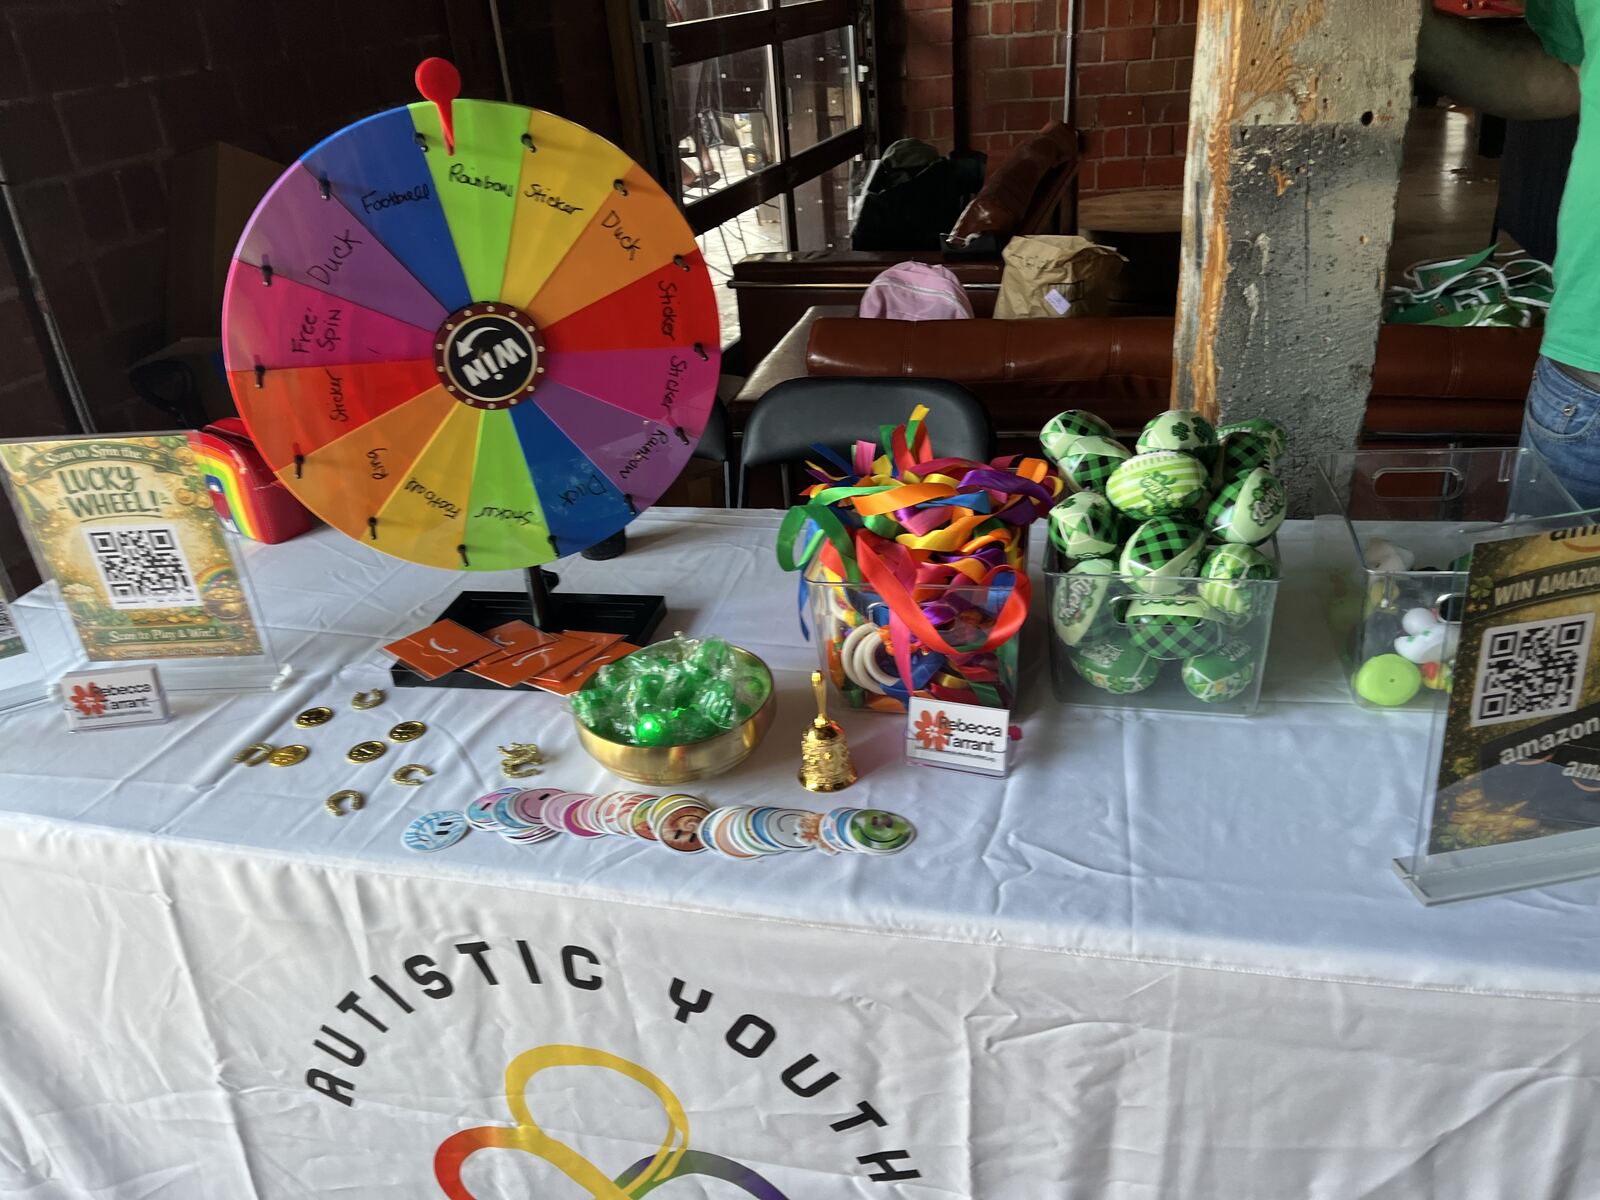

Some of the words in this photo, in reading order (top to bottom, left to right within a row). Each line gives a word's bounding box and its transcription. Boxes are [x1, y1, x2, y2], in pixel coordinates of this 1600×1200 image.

[449, 163, 513, 198] Rainbow
[524, 183, 583, 215] Sticker
[307, 229, 363, 286] Duck
[601, 210, 641, 261] Duck
[657, 280, 678, 341] Sticker
[326, 367, 348, 423] Sticker
[660, 354, 688, 415] Sticker
[366, 447, 390, 481] Ring
[619, 429, 669, 480] Rainbow
[58, 466, 141, 494] LUCKY
[404, 477, 462, 520] Football
[557, 474, 608, 506] Duck
[64, 490, 161, 518] WHEEL!
[1494, 579, 1535, 606] WIN
[1499, 717, 1600, 765] amazon
[306, 940, 602, 1106] AUTISTIC
[668, 977, 922, 1183] YOUTH
